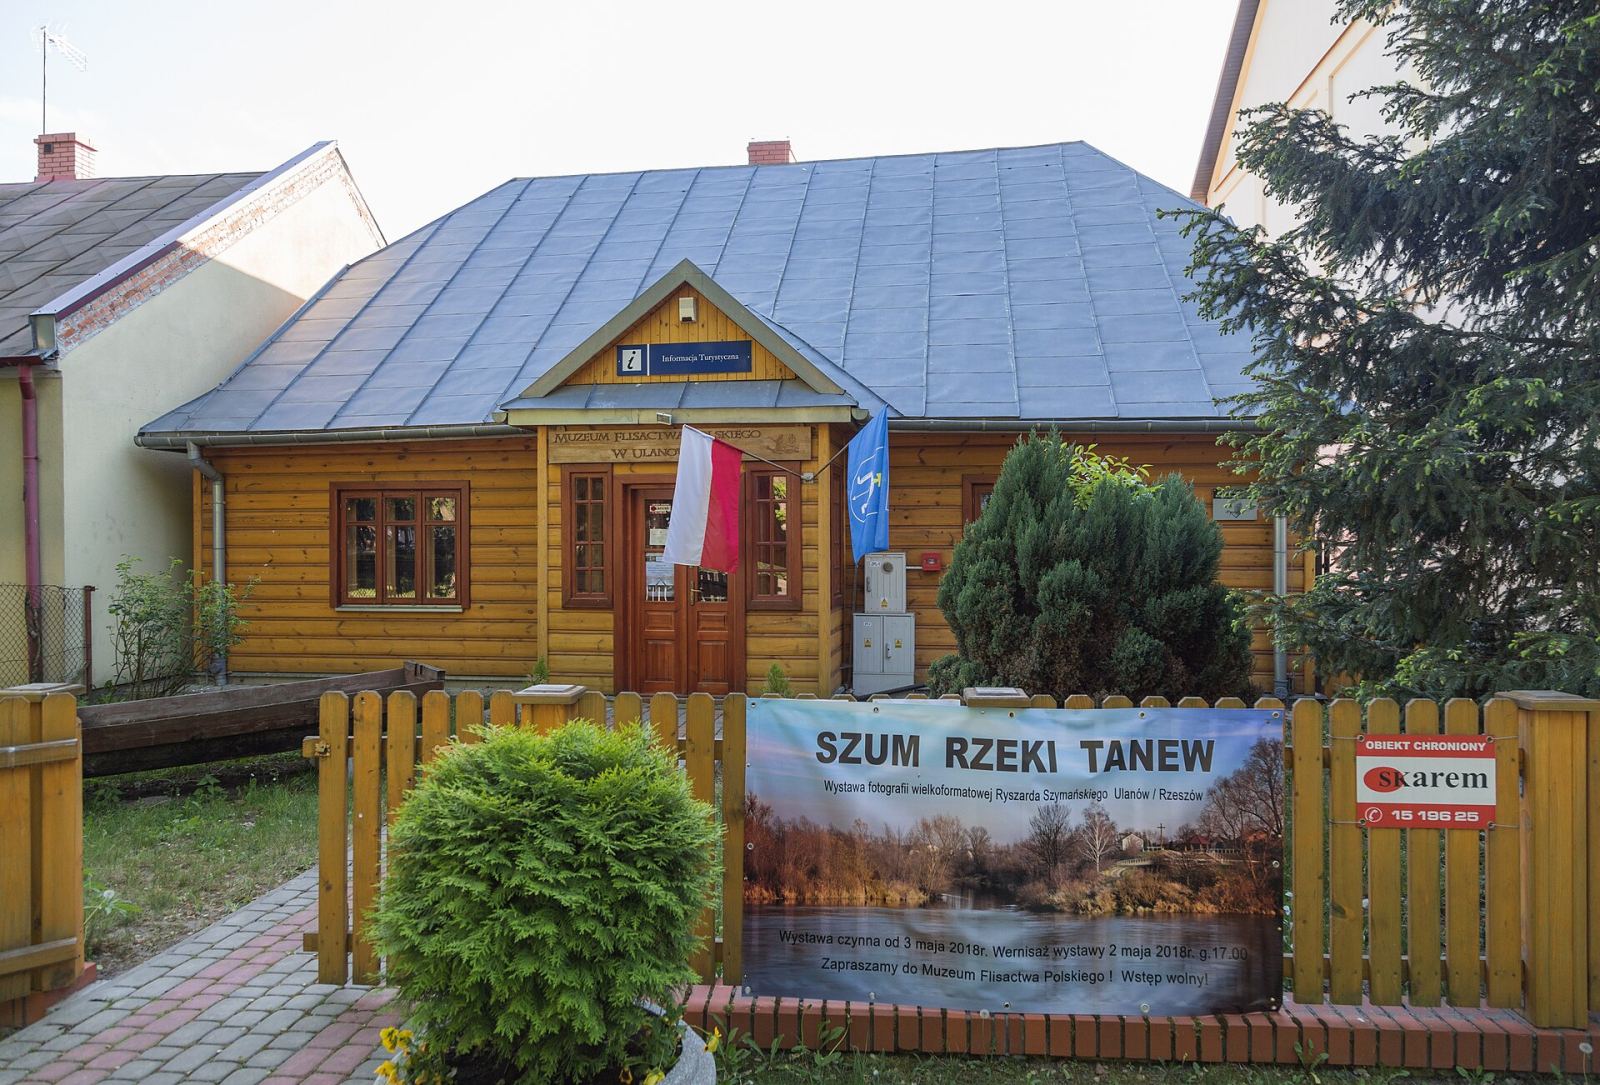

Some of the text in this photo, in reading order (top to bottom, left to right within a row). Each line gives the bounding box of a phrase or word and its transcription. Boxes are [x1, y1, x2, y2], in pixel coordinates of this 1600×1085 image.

[662, 353, 739, 363] Informacja Turystyczna
[554, 432, 610, 443] MUZEUM
[611, 447, 680, 459] W ULANO
[816, 731, 1215, 773] SZUM RZEKI TANEW
[1365, 741, 1486, 752] OBIEKT CHRONIONY
[824, 780, 1203, 802] Wystawa fotografii wielkoformatowej Ryszarda Szymańskiego Ulanów / Rzeszów
[1391, 810, 1479, 821] 15 196 25
[779, 930, 834, 946] Wystawa
[837, 935, 881, 949] czynna
[884, 936, 900, 948] od
[903, 937, 911, 949] 3
[915, 941, 945, 954] maja
[949, 942, 989, 957] 2018r.
[992, 945, 1050, 958] Wernisaż
[1053, 944, 1106, 959] wystawy
[1109, 944, 1117, 957] 2
[1121, 945, 1151, 959] maja
[1156, 945, 1195, 959] 2018r.
[821, 957, 898, 976] Zapraszamy
[902, 962, 918, 975] do
[922, 963, 976, 981] Muzeum
[980, 969, 1040, 983] Flisactwa
[1044, 970, 1105, 985] Polskiego
[1121, 971, 1163, 986] Wstęp
[1166, 972, 1209, 988] wolny!
